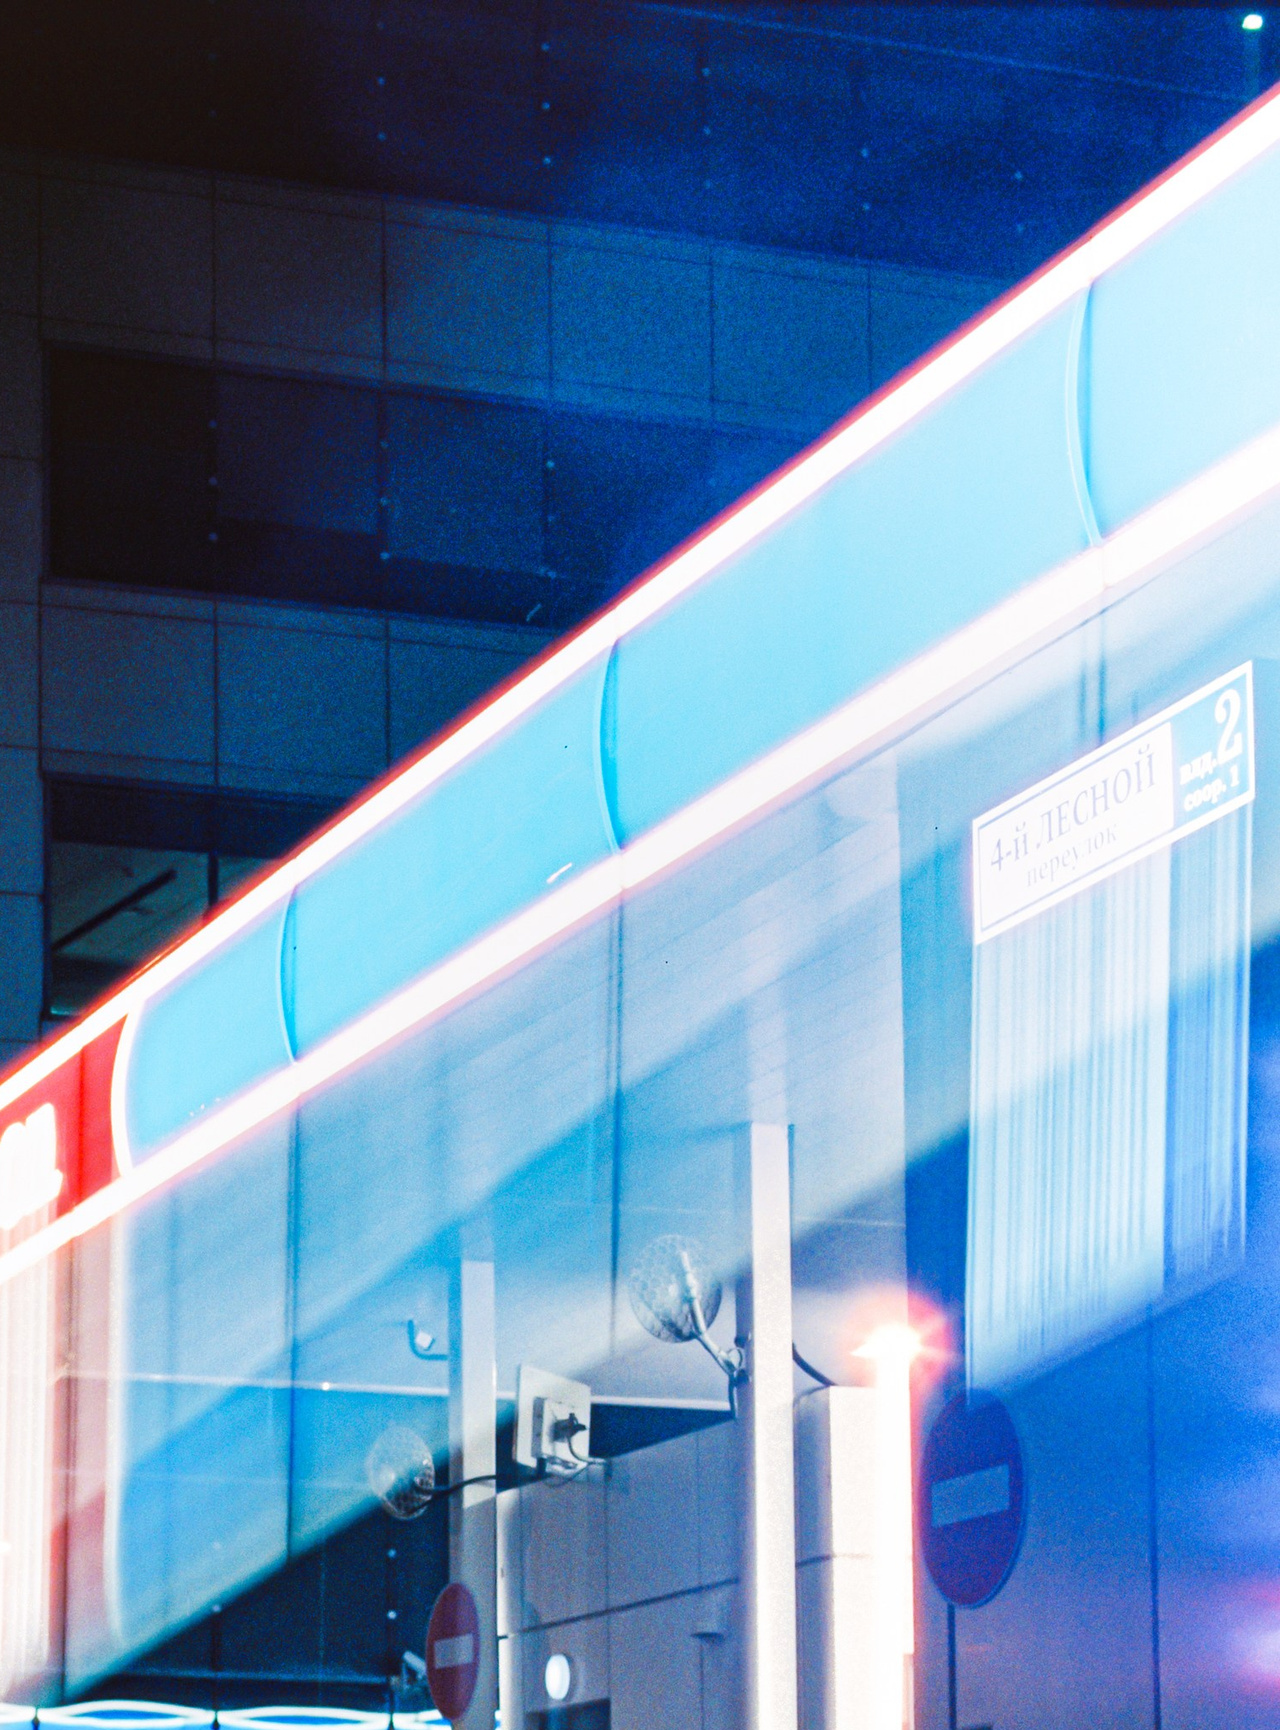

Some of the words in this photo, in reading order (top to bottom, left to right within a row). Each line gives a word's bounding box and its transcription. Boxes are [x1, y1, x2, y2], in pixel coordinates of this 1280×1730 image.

[1214, 688, 1243, 764] 2
[990, 821, 1029, 872] 4-й
[1036, 743, 1156, 850] ЛЕСНОЙ
[1229, 763, 1241, 788] 1
[1026, 822, 1118, 888] переулок
